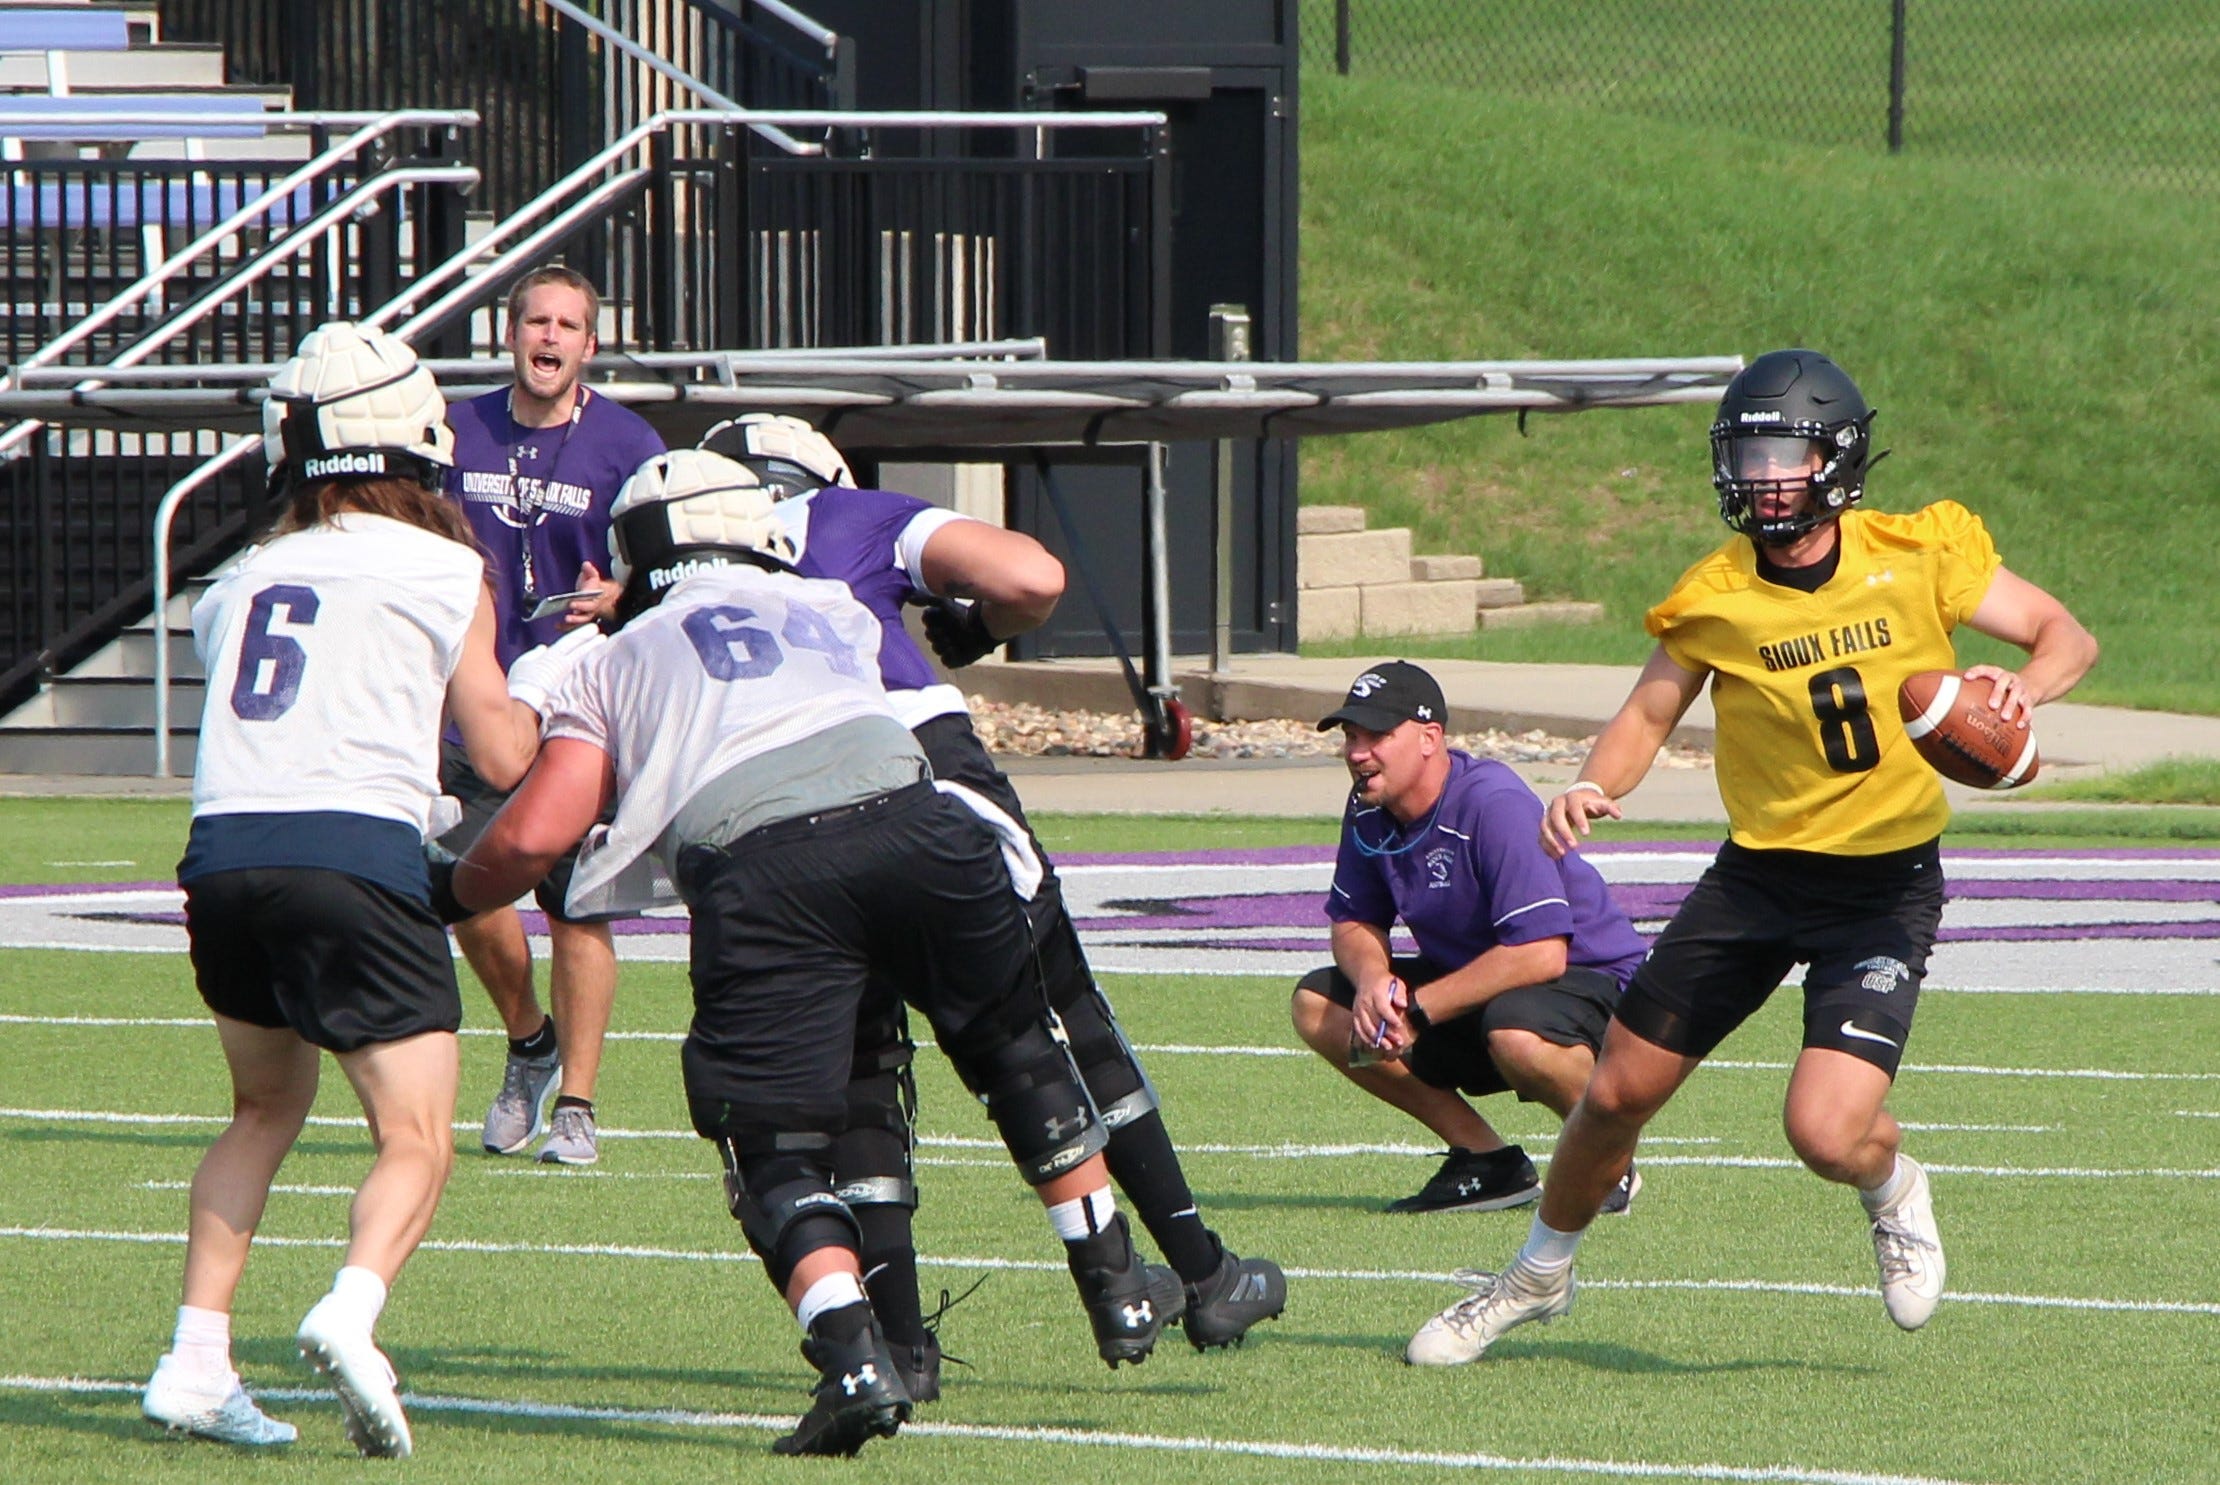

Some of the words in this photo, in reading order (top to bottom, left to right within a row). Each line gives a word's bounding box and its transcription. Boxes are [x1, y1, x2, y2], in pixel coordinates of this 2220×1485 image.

[305, 453, 386, 478] Riddell
[463, 471, 515, 495] UNIVERSIT
[560, 482, 593, 512] FALLS
[230, 584, 321, 722] 6
[681, 598, 867, 683] 64
[1758, 632, 1826, 672] SIOUX
[1829, 617, 1892, 657] FALLS
[1808, 666, 1881, 773] 8
